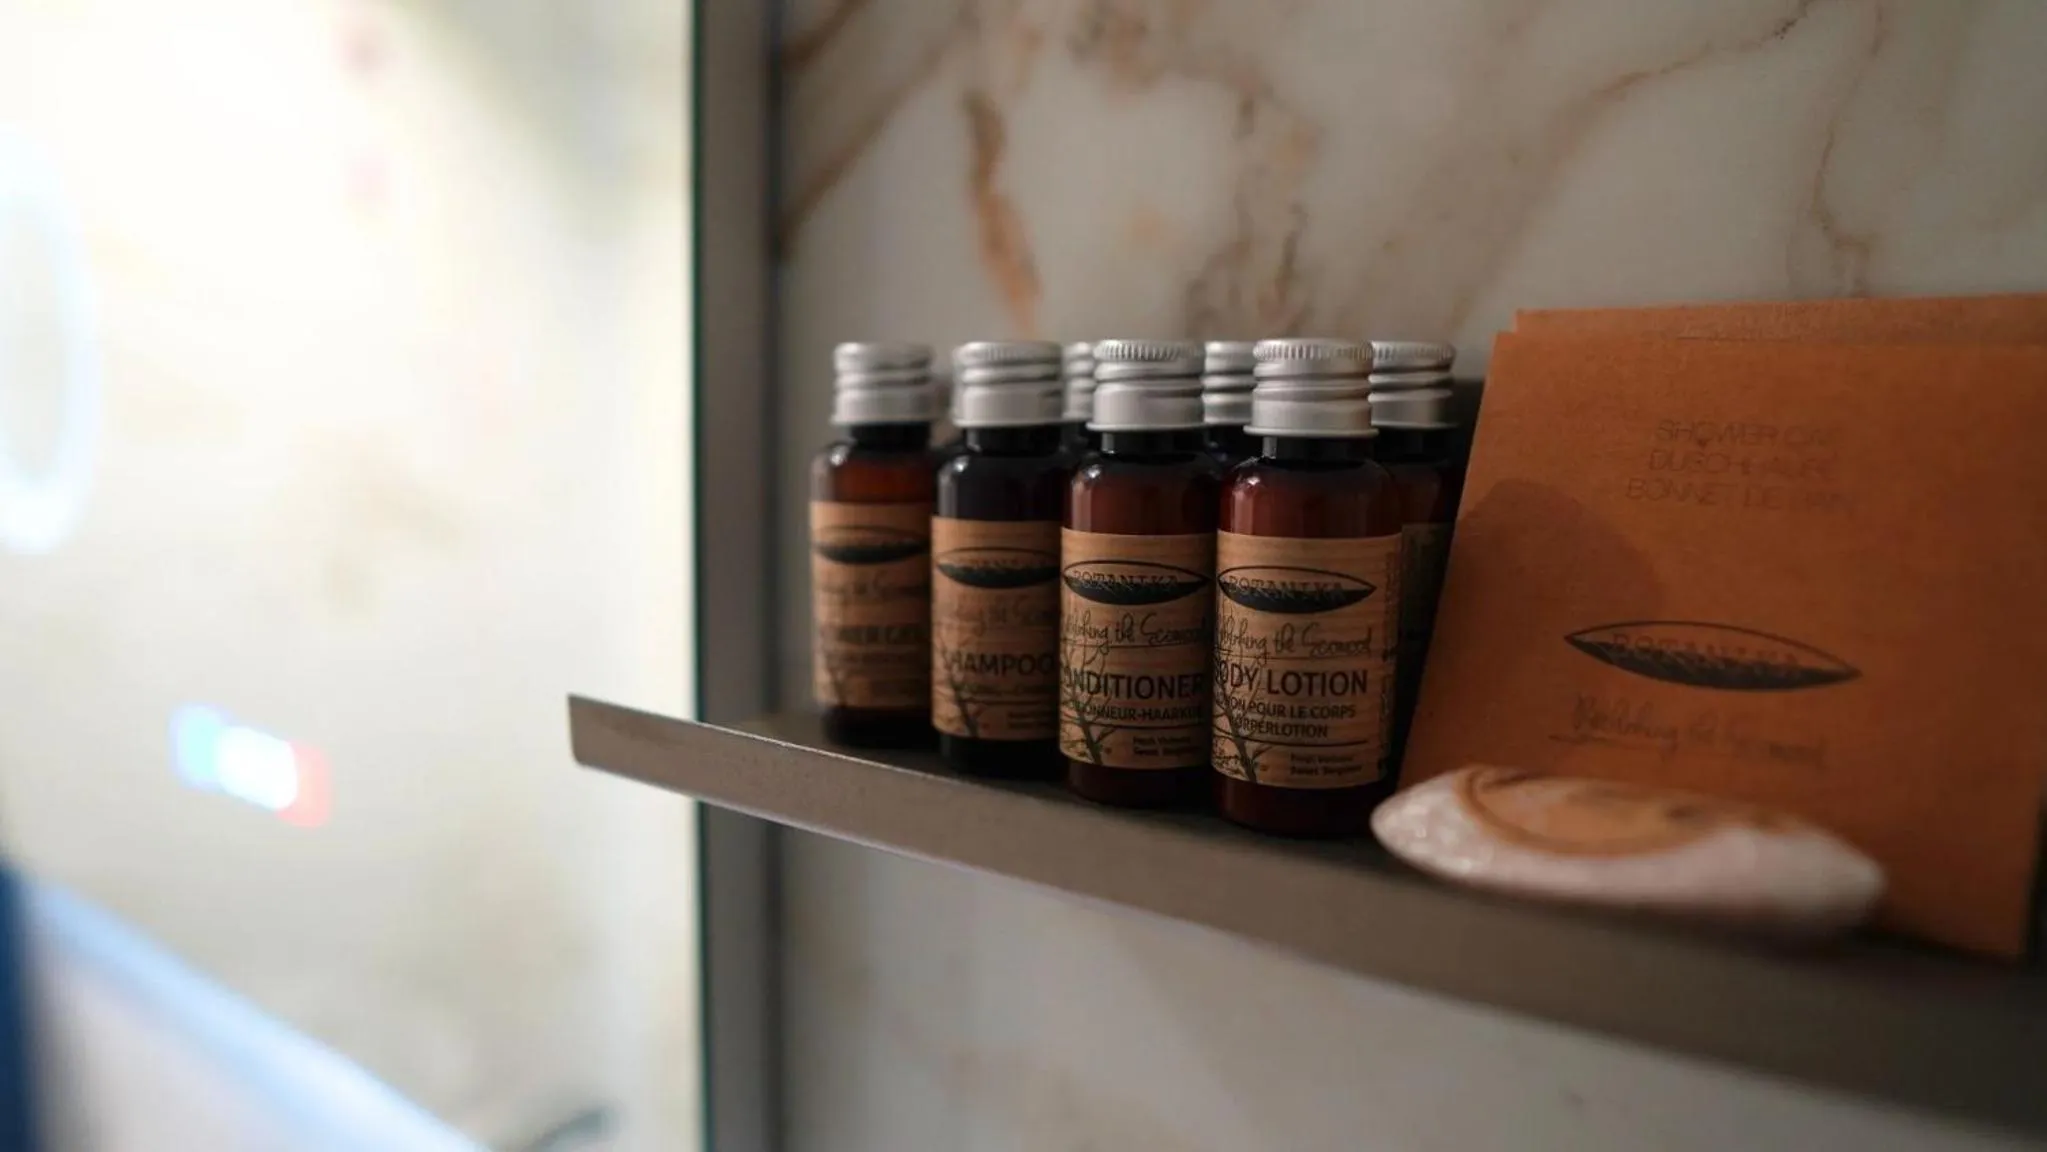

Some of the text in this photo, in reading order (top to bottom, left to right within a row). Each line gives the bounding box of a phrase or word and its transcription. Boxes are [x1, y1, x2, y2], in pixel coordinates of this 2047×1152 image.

[1267, 669, 1369, 698] LOTION
[1290, 704, 1307, 719] LE
[1310, 704, 1357, 720] CORPS
